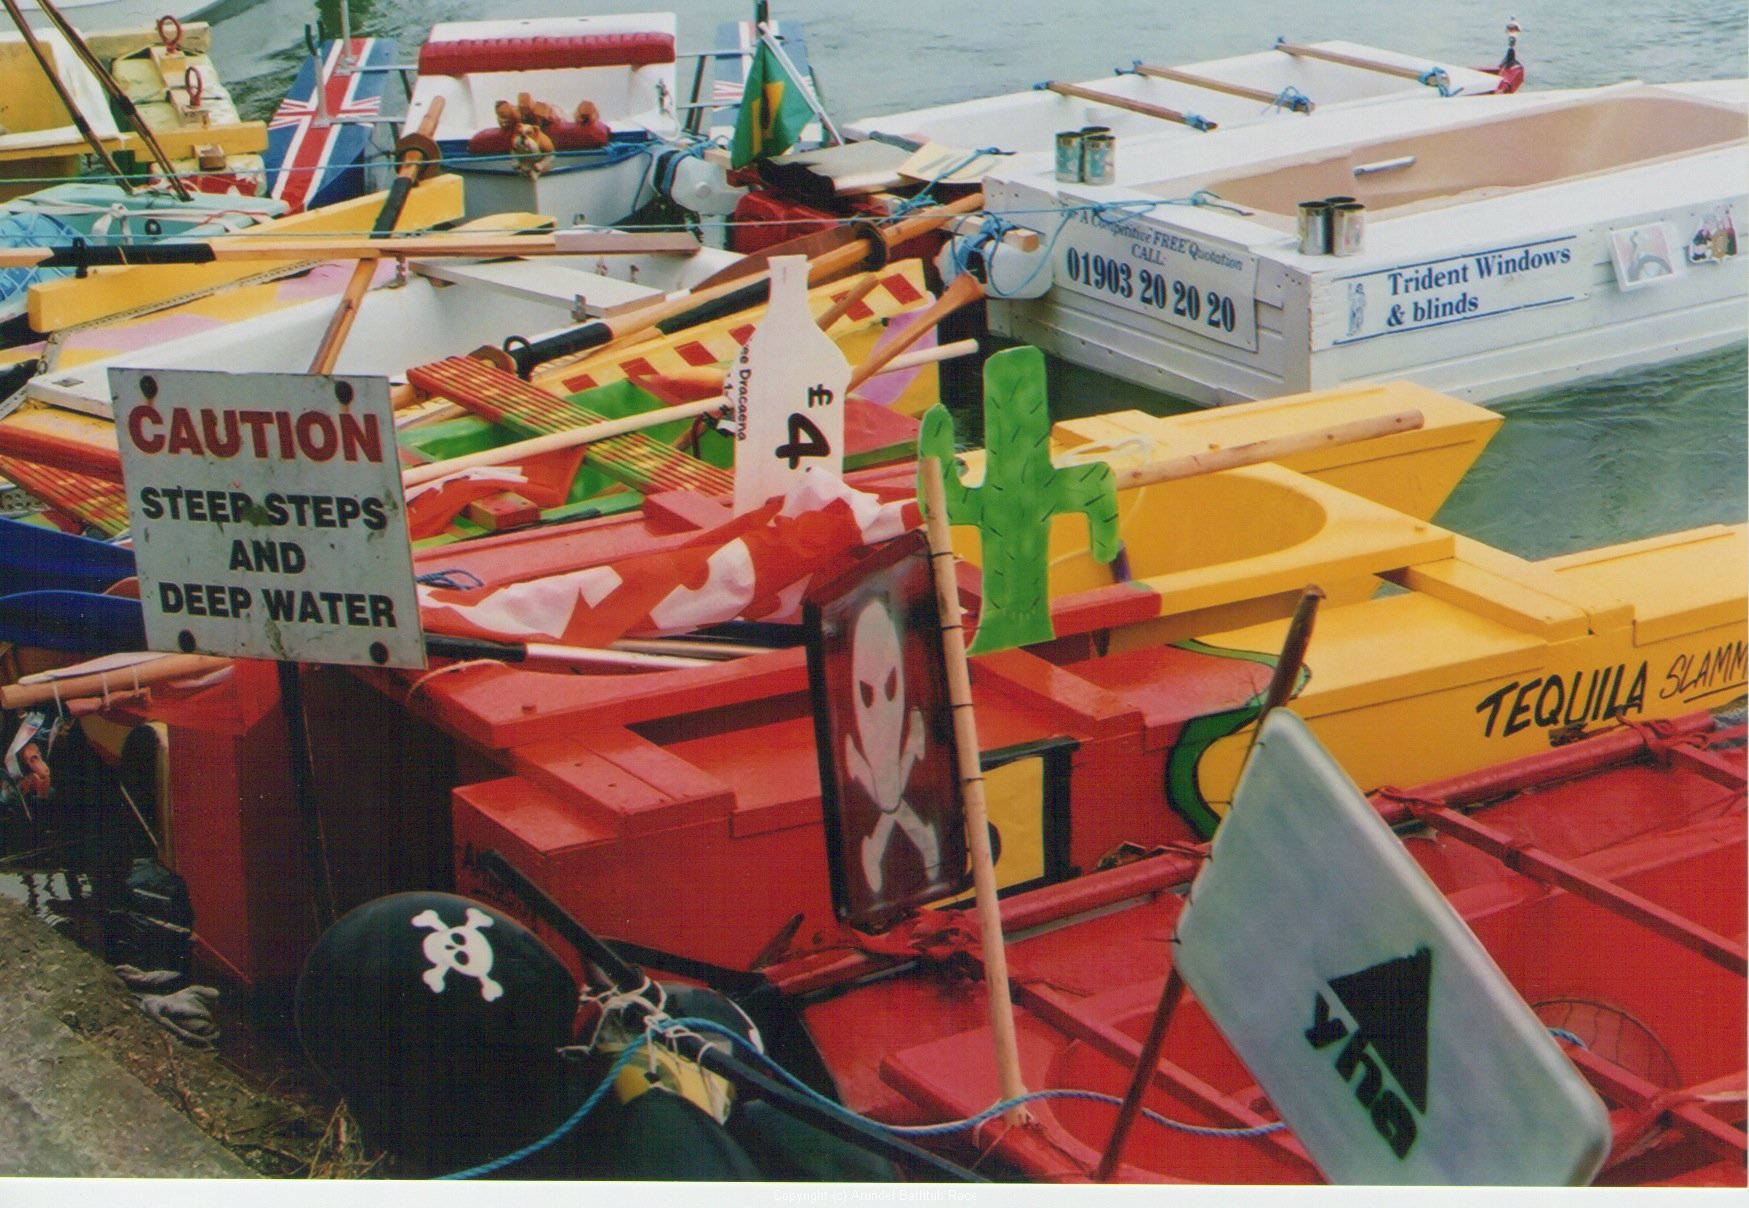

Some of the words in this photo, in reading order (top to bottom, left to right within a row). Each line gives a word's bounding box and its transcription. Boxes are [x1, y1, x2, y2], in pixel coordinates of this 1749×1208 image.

[1188, 241, 1243, 271] Quotation
[1387, 263, 1470, 296] Trident
[1475, 247, 1572, 279] Windows
[1067, 246, 1132, 298] 01903
[1139, 269, 1167, 309] 20
[1173, 280, 1200, 321] 20
[1207, 292, 1236, 332] 20
[1387, 303, 1406, 327] &
[1413, 292, 1479, 322] blinds
[738, 369, 751, 441] Dracaena
[128, 404, 383, 463] CAUTION
[140, 486, 253, 523] STEEP
[264, 493, 387, 530] STEPS
[229, 539, 306, 574] AND
[158, 581, 252, 618] DEEP
[262, 588, 397, 627] WATER
[1476, 660, 1649, 738] TEQUILA
